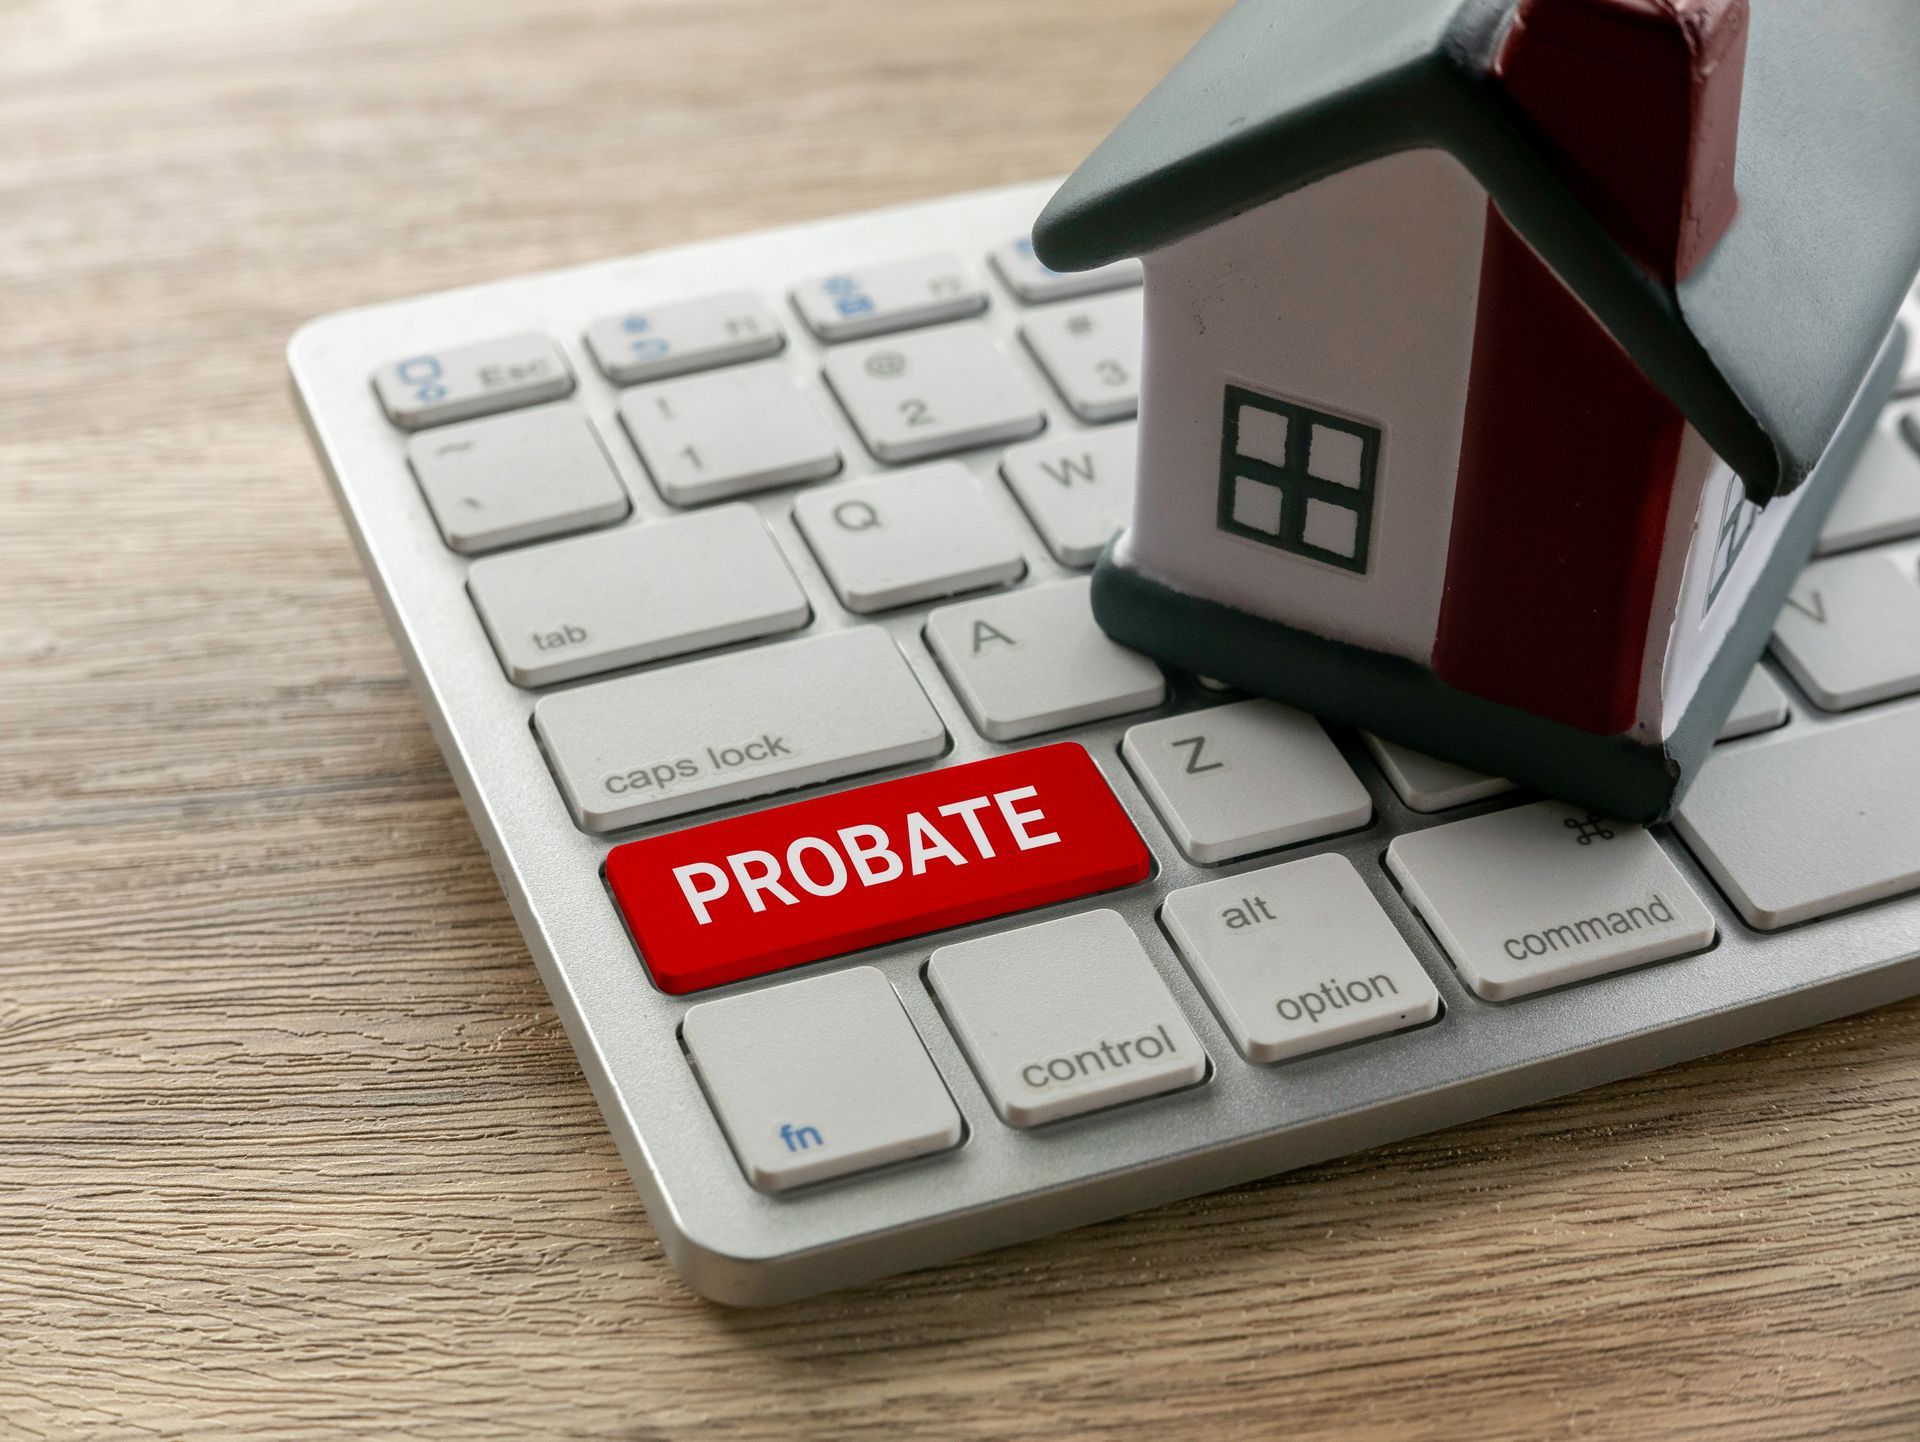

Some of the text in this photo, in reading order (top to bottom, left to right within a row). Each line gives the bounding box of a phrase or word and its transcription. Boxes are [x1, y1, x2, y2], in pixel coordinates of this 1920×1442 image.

[477, 357, 553, 388] Esc
[863, 350, 907, 381] @
[1095, 358, 1129, 387] 3
[898, 399, 936, 428] 2
[679, 444, 706, 472] 1
[1040, 451, 1096, 489] W
[832, 499, 882, 534] Q
[533, 622, 588, 653] tab
[970, 618, 1016, 655] A
[604, 733, 793, 795] caps lock
[1171, 735, 1223, 775] Z
[671, 784, 1062, 926] PROBATE
[1220, 894, 1278, 931] alt
[1503, 894, 1675, 962] command
[1275, 970, 1398, 1023] option
[1021, 1025, 1176, 1088] control
[779, 1122, 824, 1154] fn
